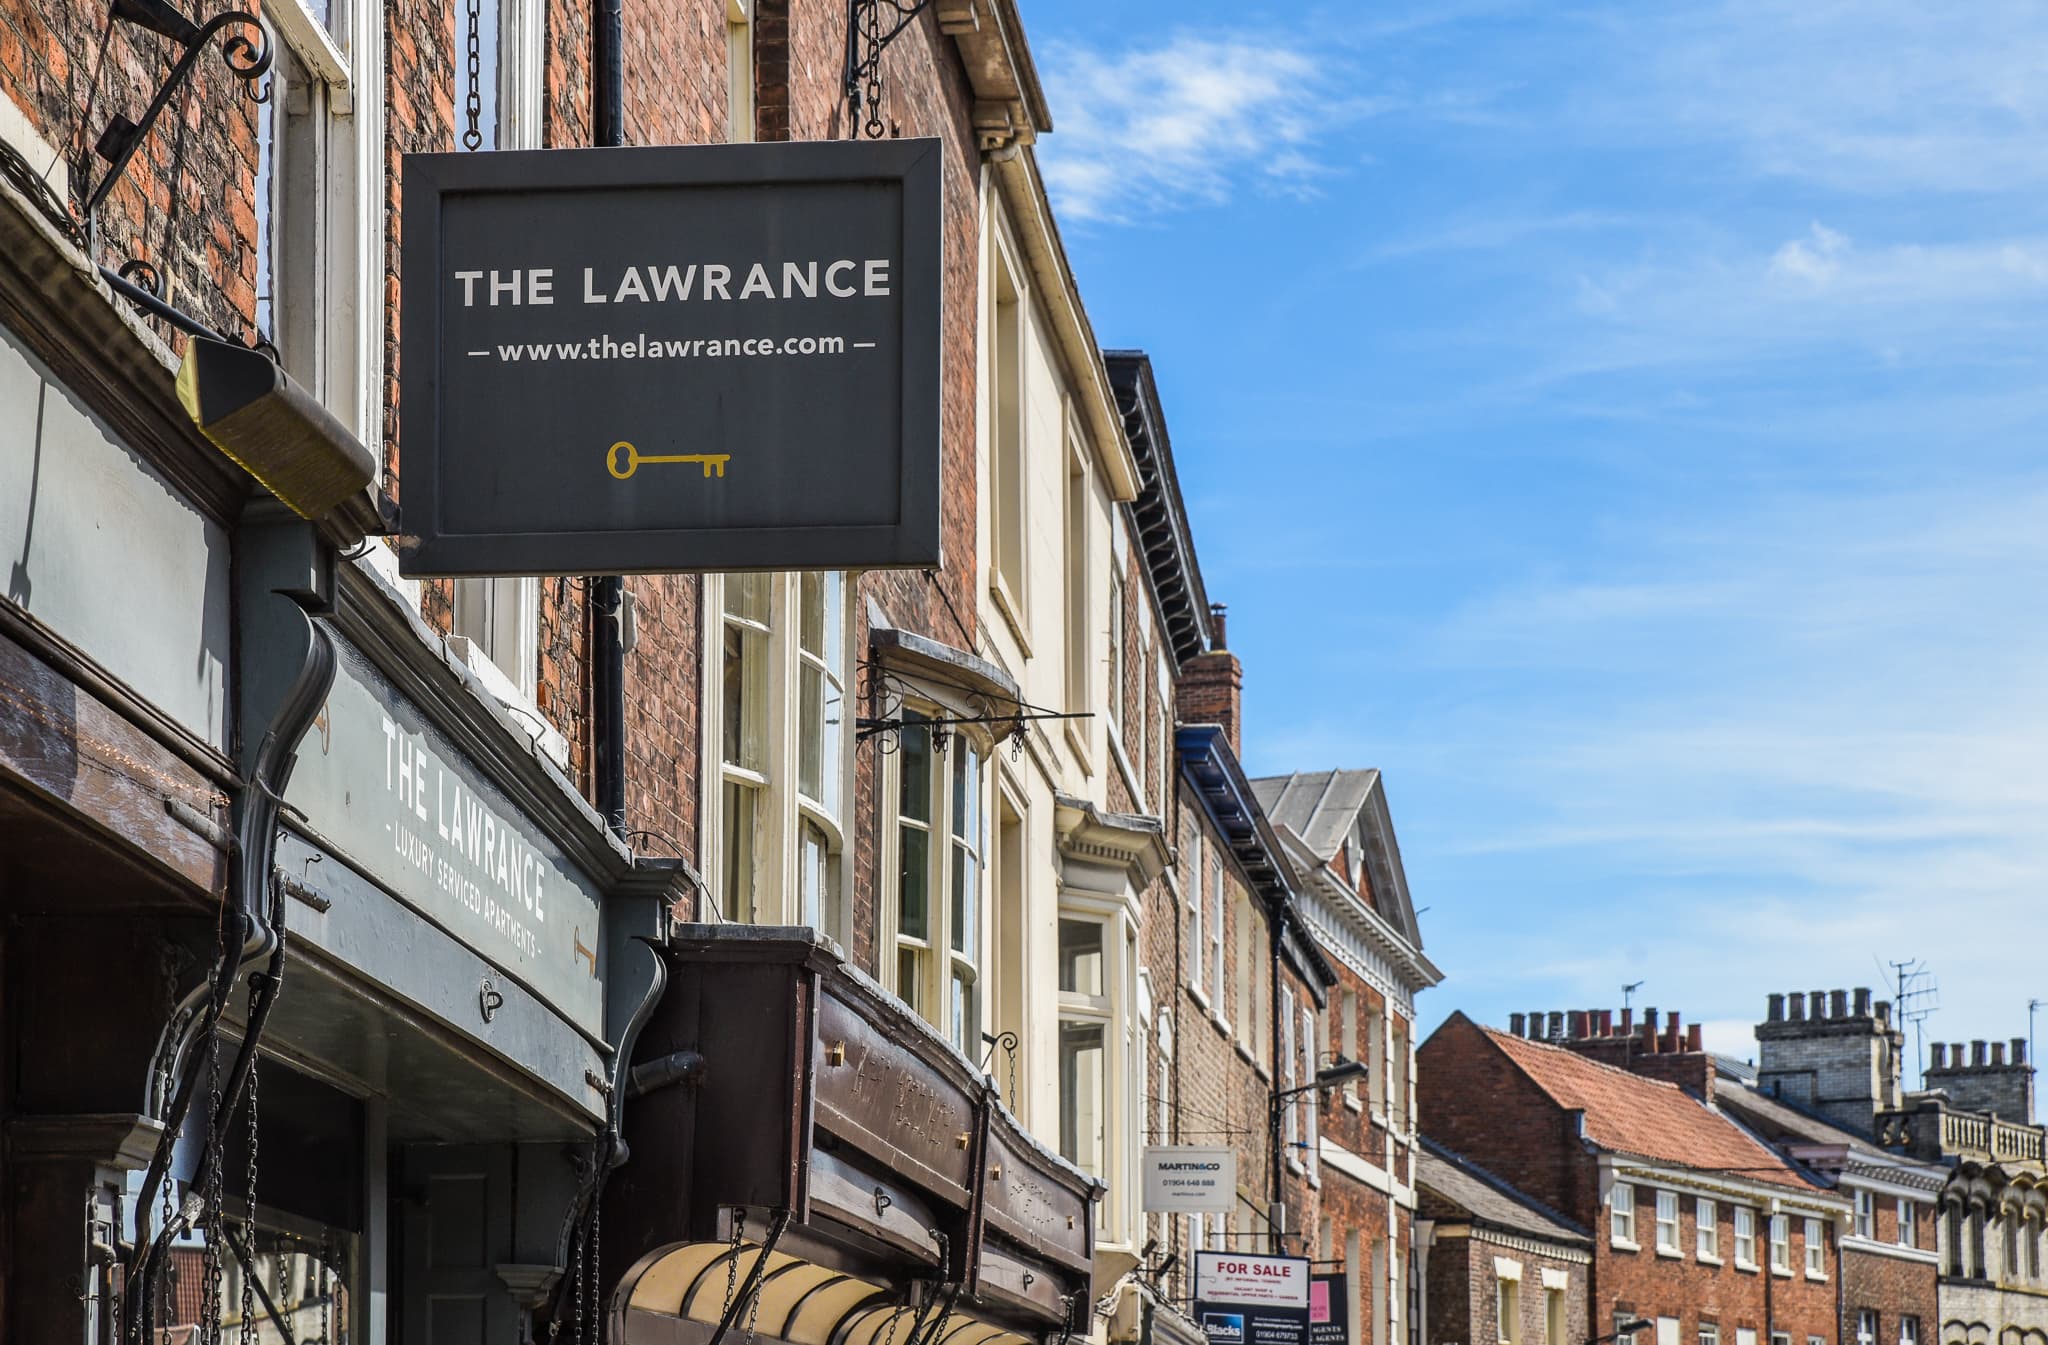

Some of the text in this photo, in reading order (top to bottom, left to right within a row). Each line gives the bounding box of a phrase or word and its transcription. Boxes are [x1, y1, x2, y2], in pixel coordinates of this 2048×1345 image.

[455, 260, 891, 307] THE LAWRANCE
[498, 334, 845, 361] www.thelawrance.com
[383, 716, 545, 922] THE LAWRANCE
[395, 820, 536, 959] LUXURY SERVICED APARTMENTS
[1158, 1162, 1220, 1171] MARTIN&CO
[1162, 1179, 1185, 1187] 01904
[1217, 1262, 1292, 1278] FOR SALE
[1206, 1324, 1241, 1337] Blacks
